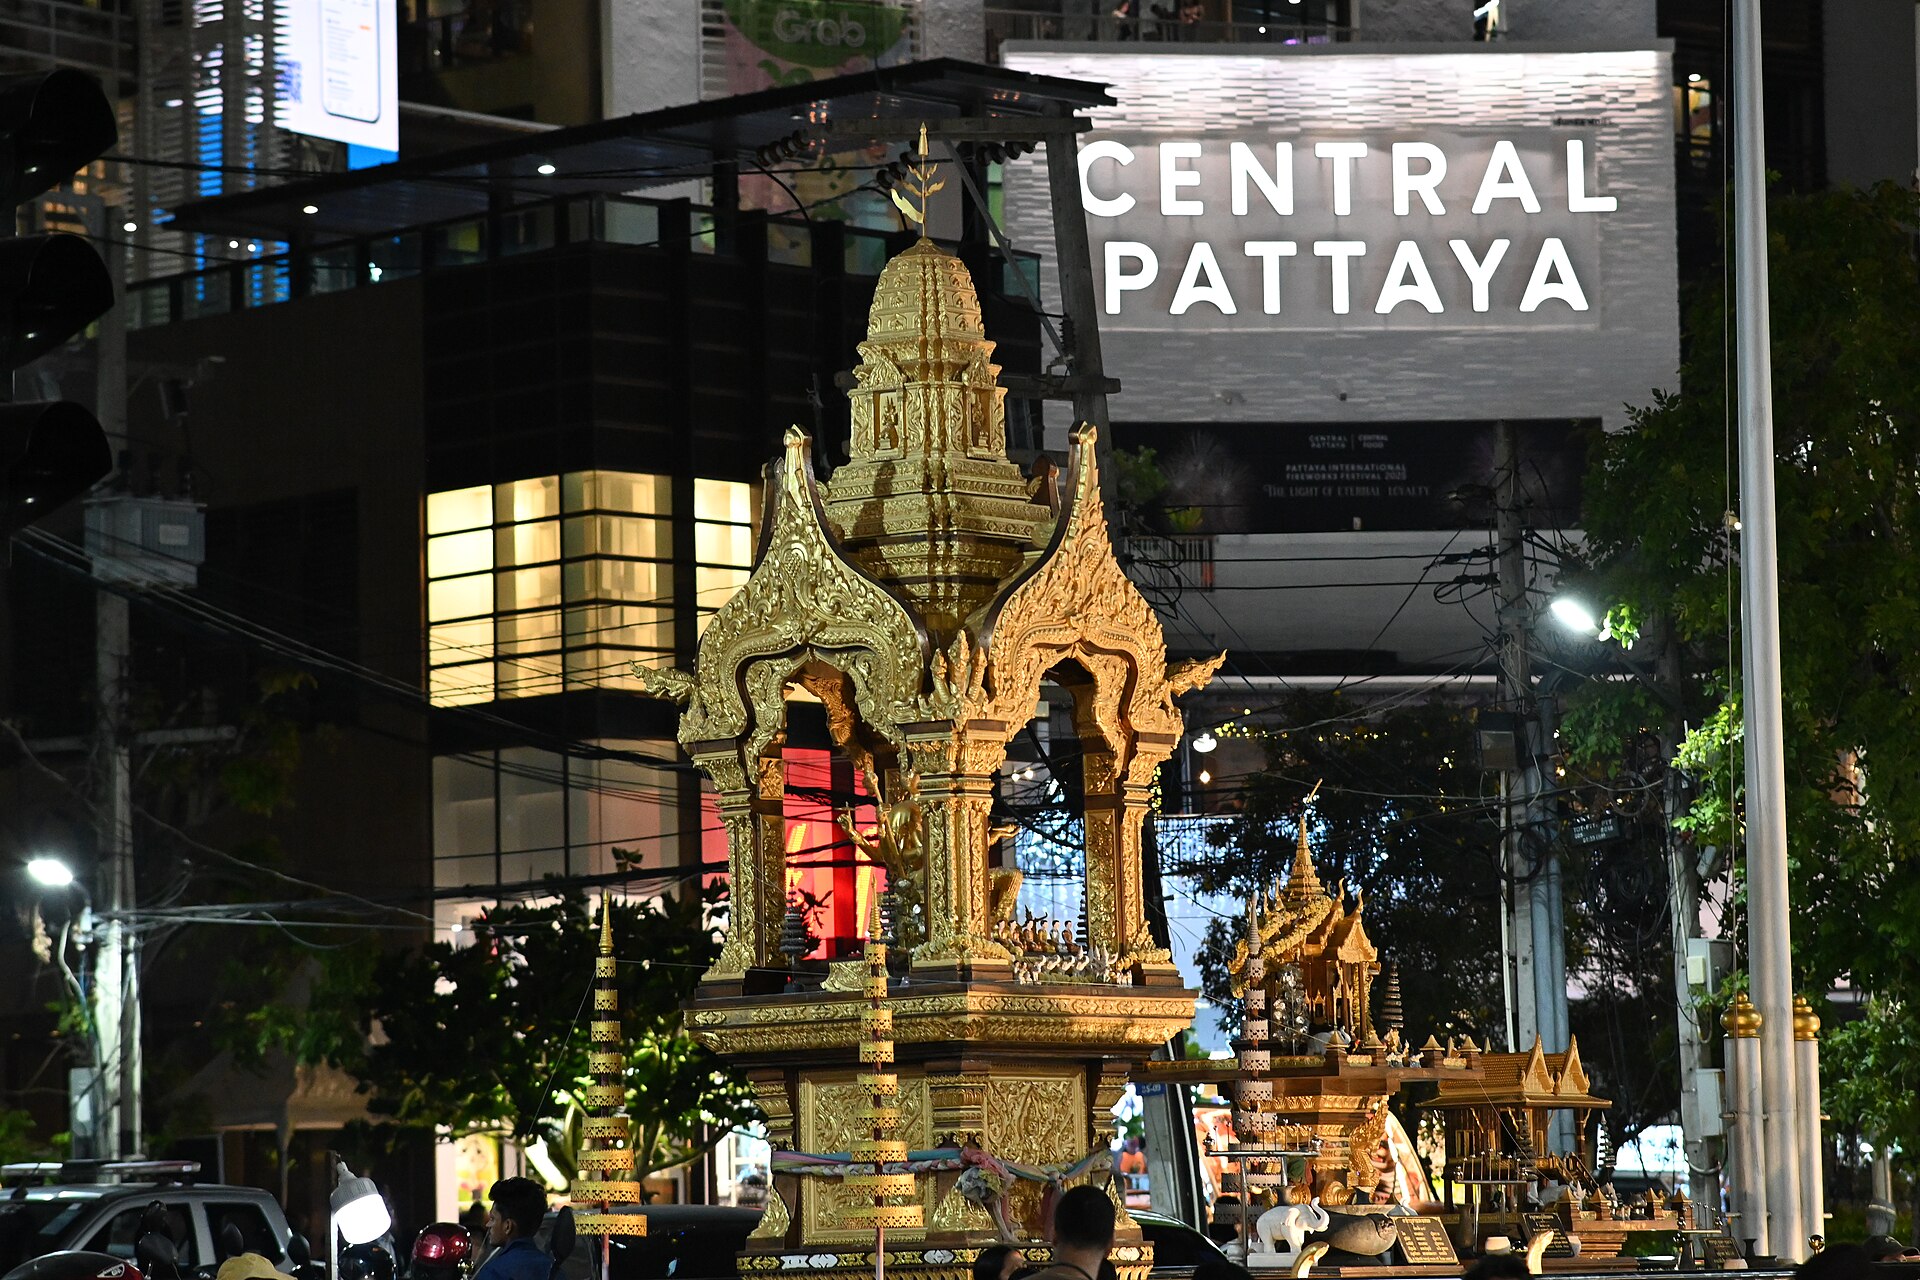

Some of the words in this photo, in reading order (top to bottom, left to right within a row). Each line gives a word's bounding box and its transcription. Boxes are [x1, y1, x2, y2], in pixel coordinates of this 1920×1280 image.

[773, 9, 866, 48] Grab
[1076, 140, 1618, 217] CENTRAL
[1104, 237, 1589, 315] PATTAYA
[1286, 463, 1327, 473] PATTAYA
[1328, 463, 1406, 472] INTERNATIONAL
[1286, 472, 1338, 481] FIREWORKS
[1340, 472, 1382, 481] FESTIVAL
[1289, 485, 1319, 497] LIGHT
[1321, 485, 1335, 497] OF
[1387, 485, 1431, 497] LOYALTY
